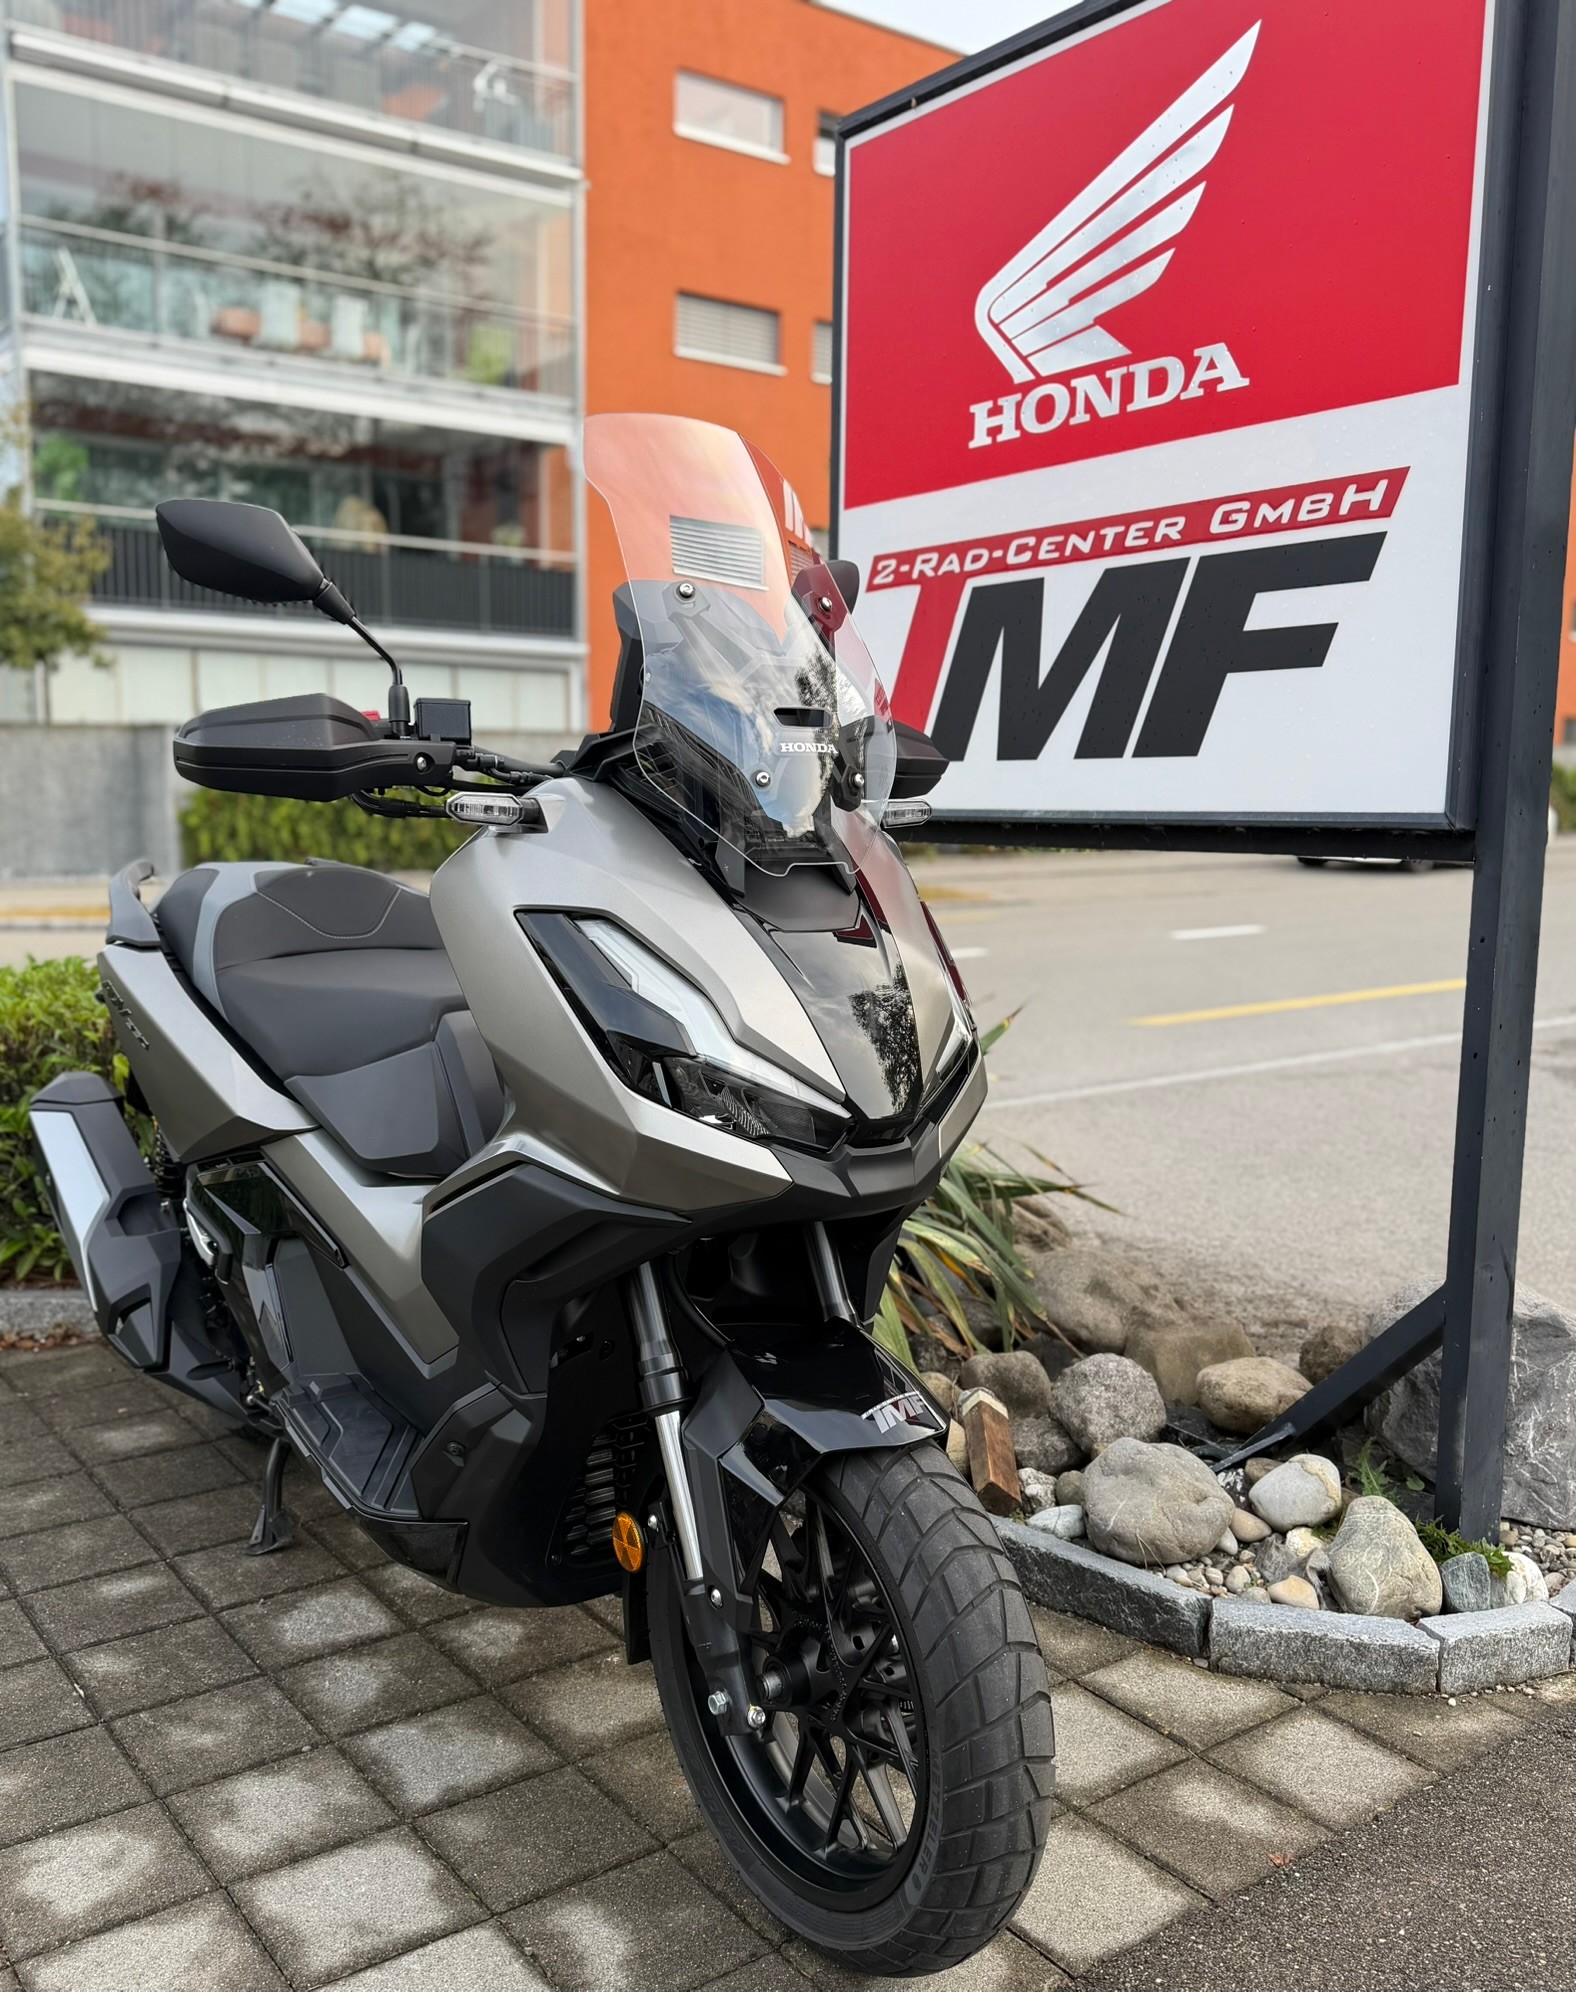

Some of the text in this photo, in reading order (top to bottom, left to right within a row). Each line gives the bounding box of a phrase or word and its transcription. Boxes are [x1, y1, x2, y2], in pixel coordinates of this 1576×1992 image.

[968, 342, 1250, 449] HONDA
[873, 515, 1188, 587] 2-RAD-CENTER
[886, 531, 1388, 762] TMF
[780, 742, 839, 755] HONDA
[866, 1392, 924, 1434] TMF
